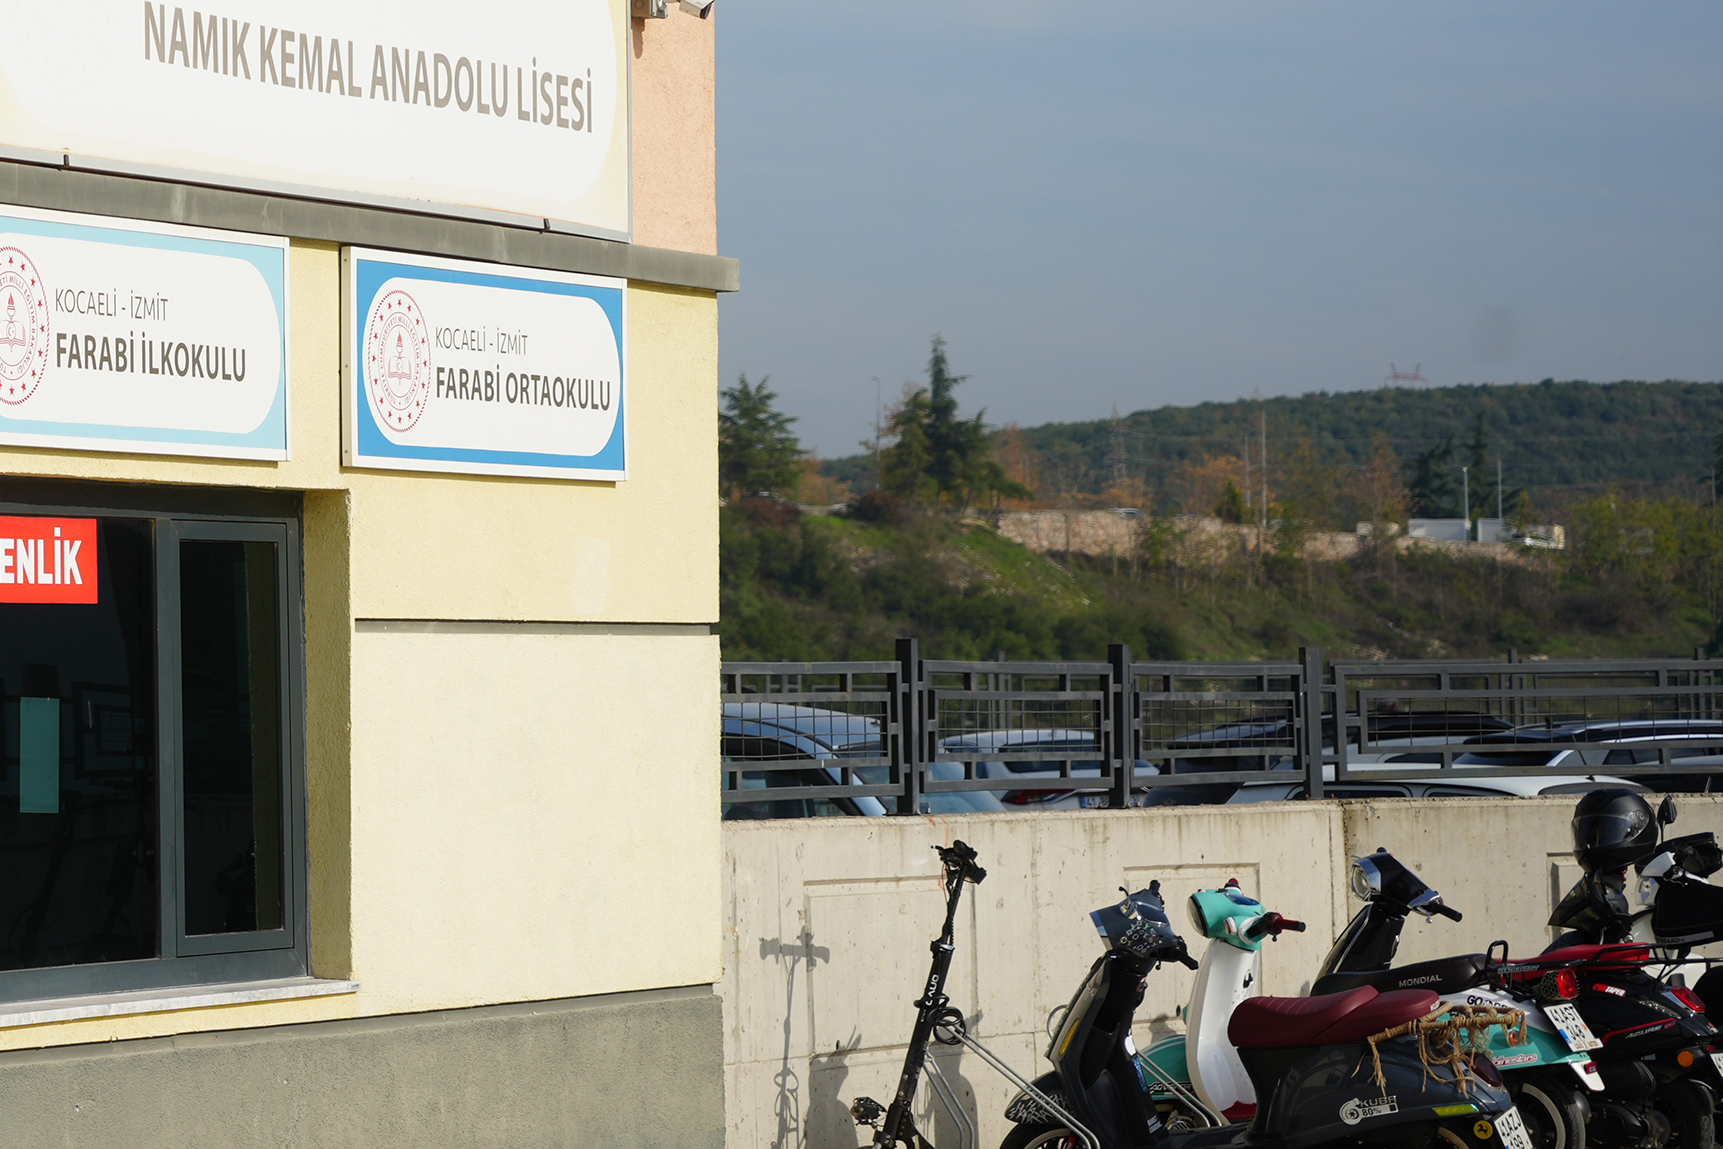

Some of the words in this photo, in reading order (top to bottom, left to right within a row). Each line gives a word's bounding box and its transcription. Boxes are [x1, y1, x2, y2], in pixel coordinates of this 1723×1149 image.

[143, 0, 251, 81] NAMIK
[260, 26, 362, 99] KEMAL
[369, 44, 509, 119] ANADOLU
[517, 55, 593, 133] LİSESİ
[55, 288, 117, 317] KOCAELİ
[130, 290, 168, 322] İZMİT
[56, 331, 134, 374] FARABİ
[142, 332, 246, 382] İLKOKULU
[435, 325, 486, 352] KOCAELİ
[496, 327, 528, 356] İZMİT
[436, 364, 500, 403] FARABİ
[506, 370, 611, 411] ORTAOKULU
[1398, 974, 1442, 988] MONDIAL
[1361, 1107, 1382, 1117] 80%
